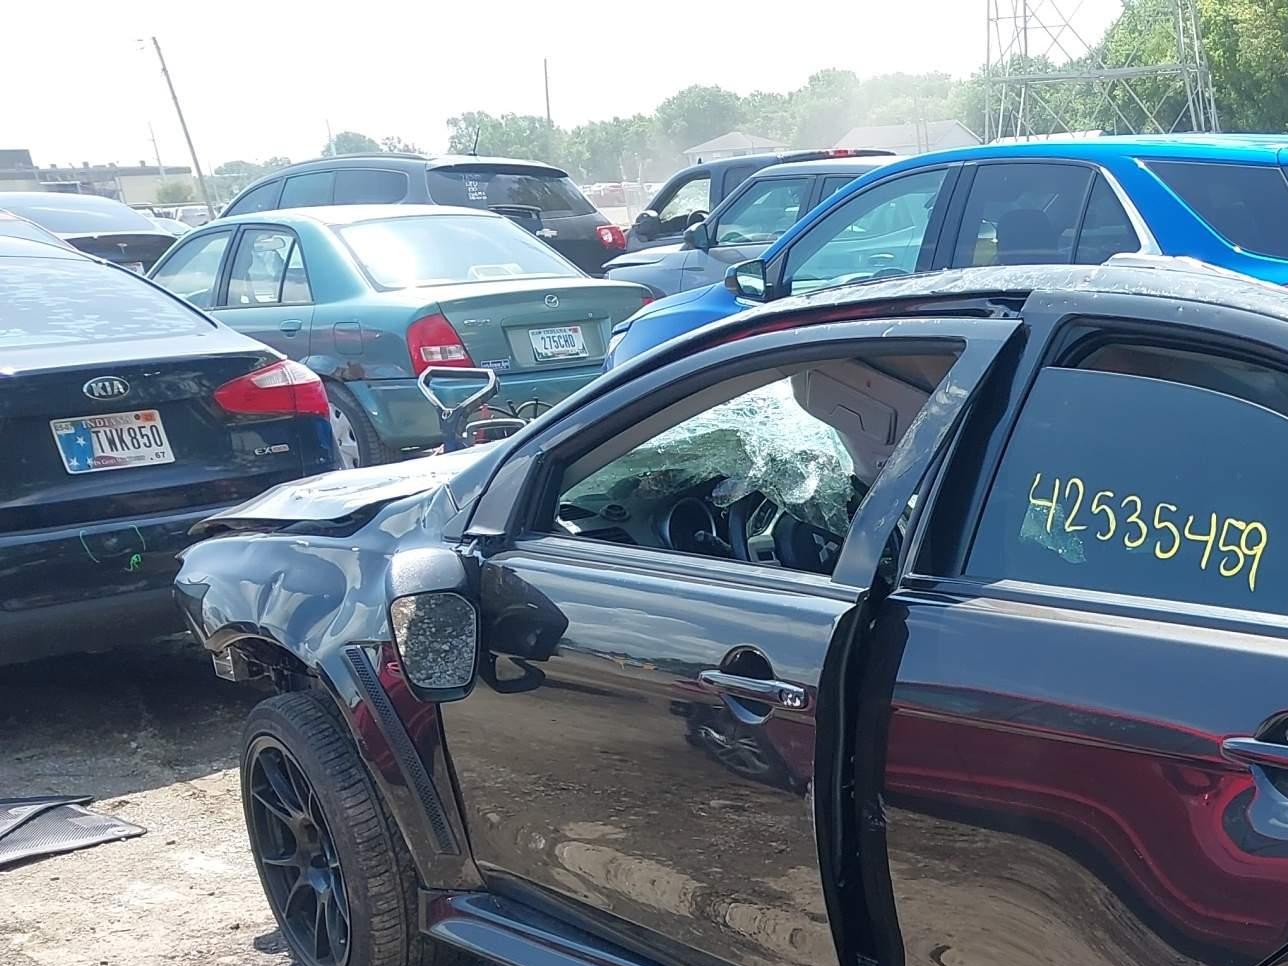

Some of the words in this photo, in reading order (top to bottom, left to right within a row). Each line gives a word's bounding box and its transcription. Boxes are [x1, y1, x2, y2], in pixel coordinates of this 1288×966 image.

[91, 381, 125, 396] KIA
[92, 424, 163, 453] TWK850
[1029, 473, 1268, 592] 42535459
